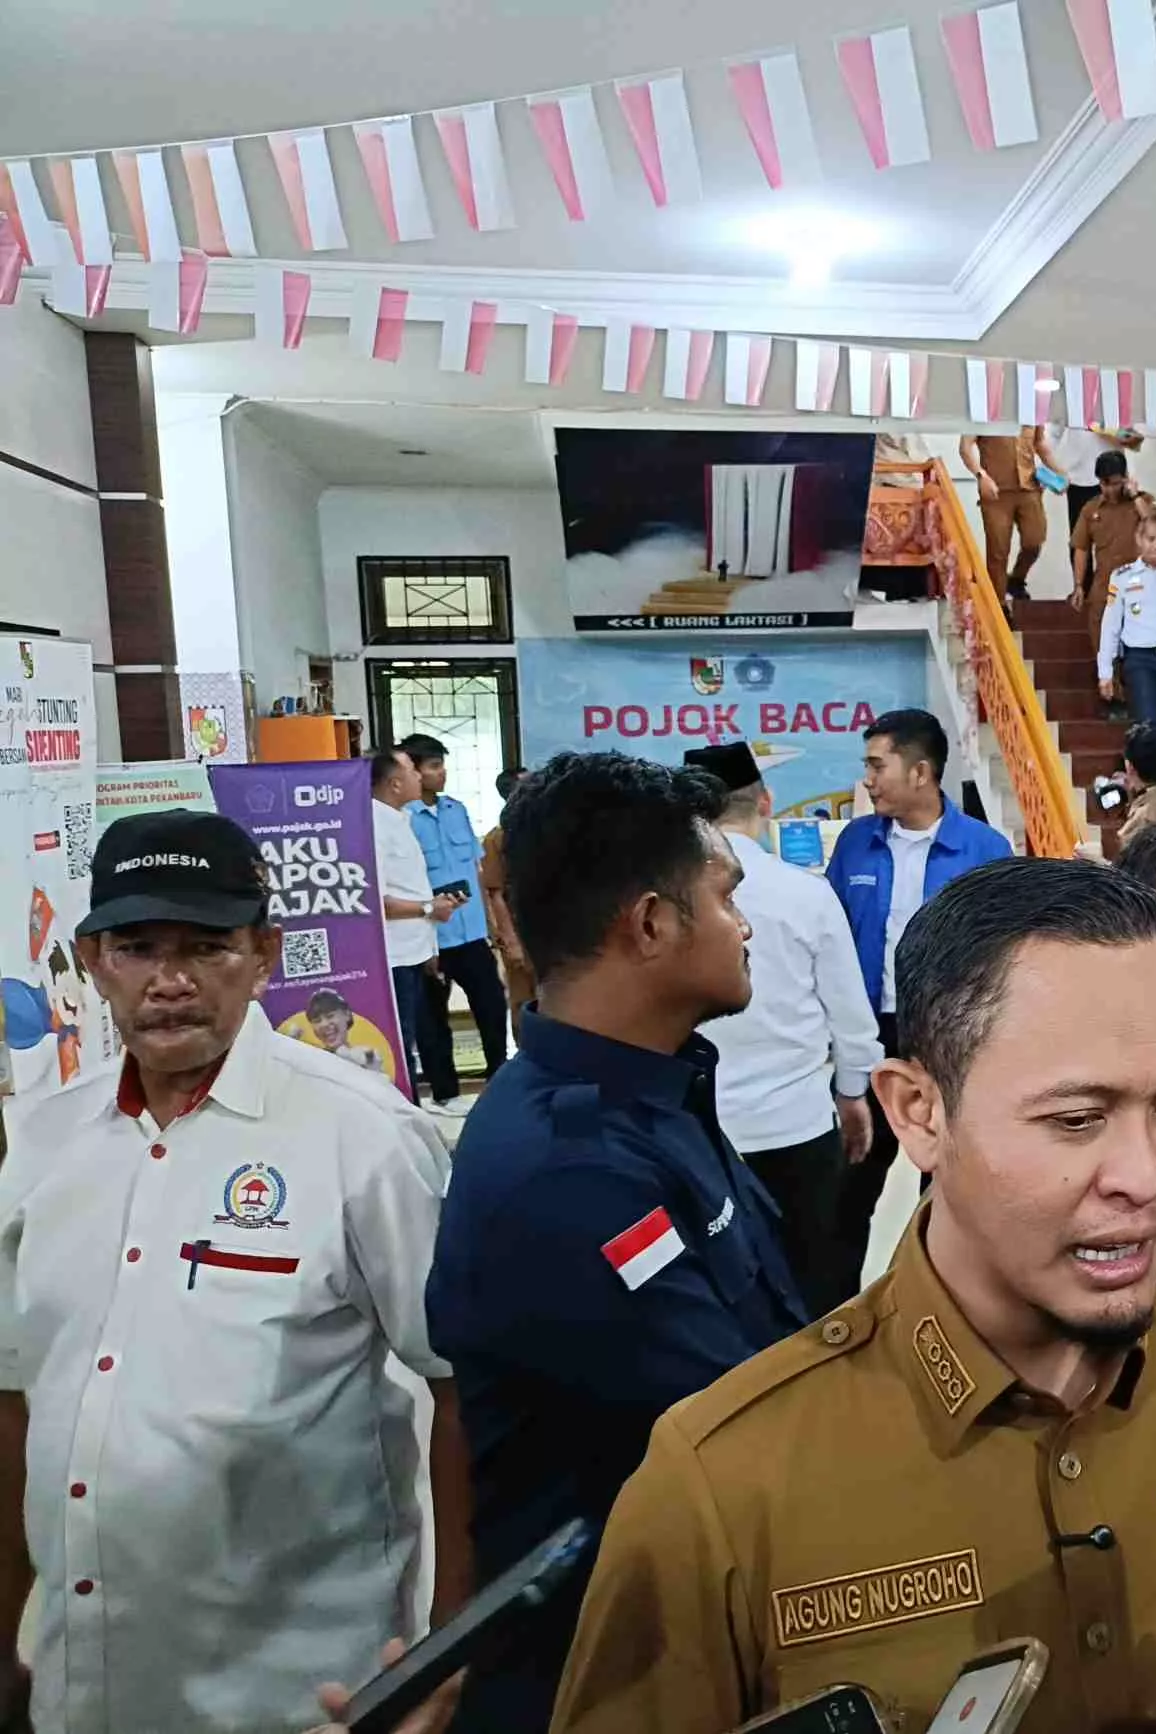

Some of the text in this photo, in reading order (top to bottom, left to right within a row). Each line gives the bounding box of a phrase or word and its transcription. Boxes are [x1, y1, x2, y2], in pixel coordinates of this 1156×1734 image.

[664, 614, 720, 627] RUANG
[725, 613, 794, 626] LAKTASI
[583, 701, 876, 738] POJOK BACA
[252, 819, 342, 834] www.pajak.go.id
[114, 853, 211, 874] INDONESIA
[260, 836, 339, 865] AKU
[267, 888, 372, 918] AJAK
[785, 1561, 973, 1635] AGUNG NUGROHO
